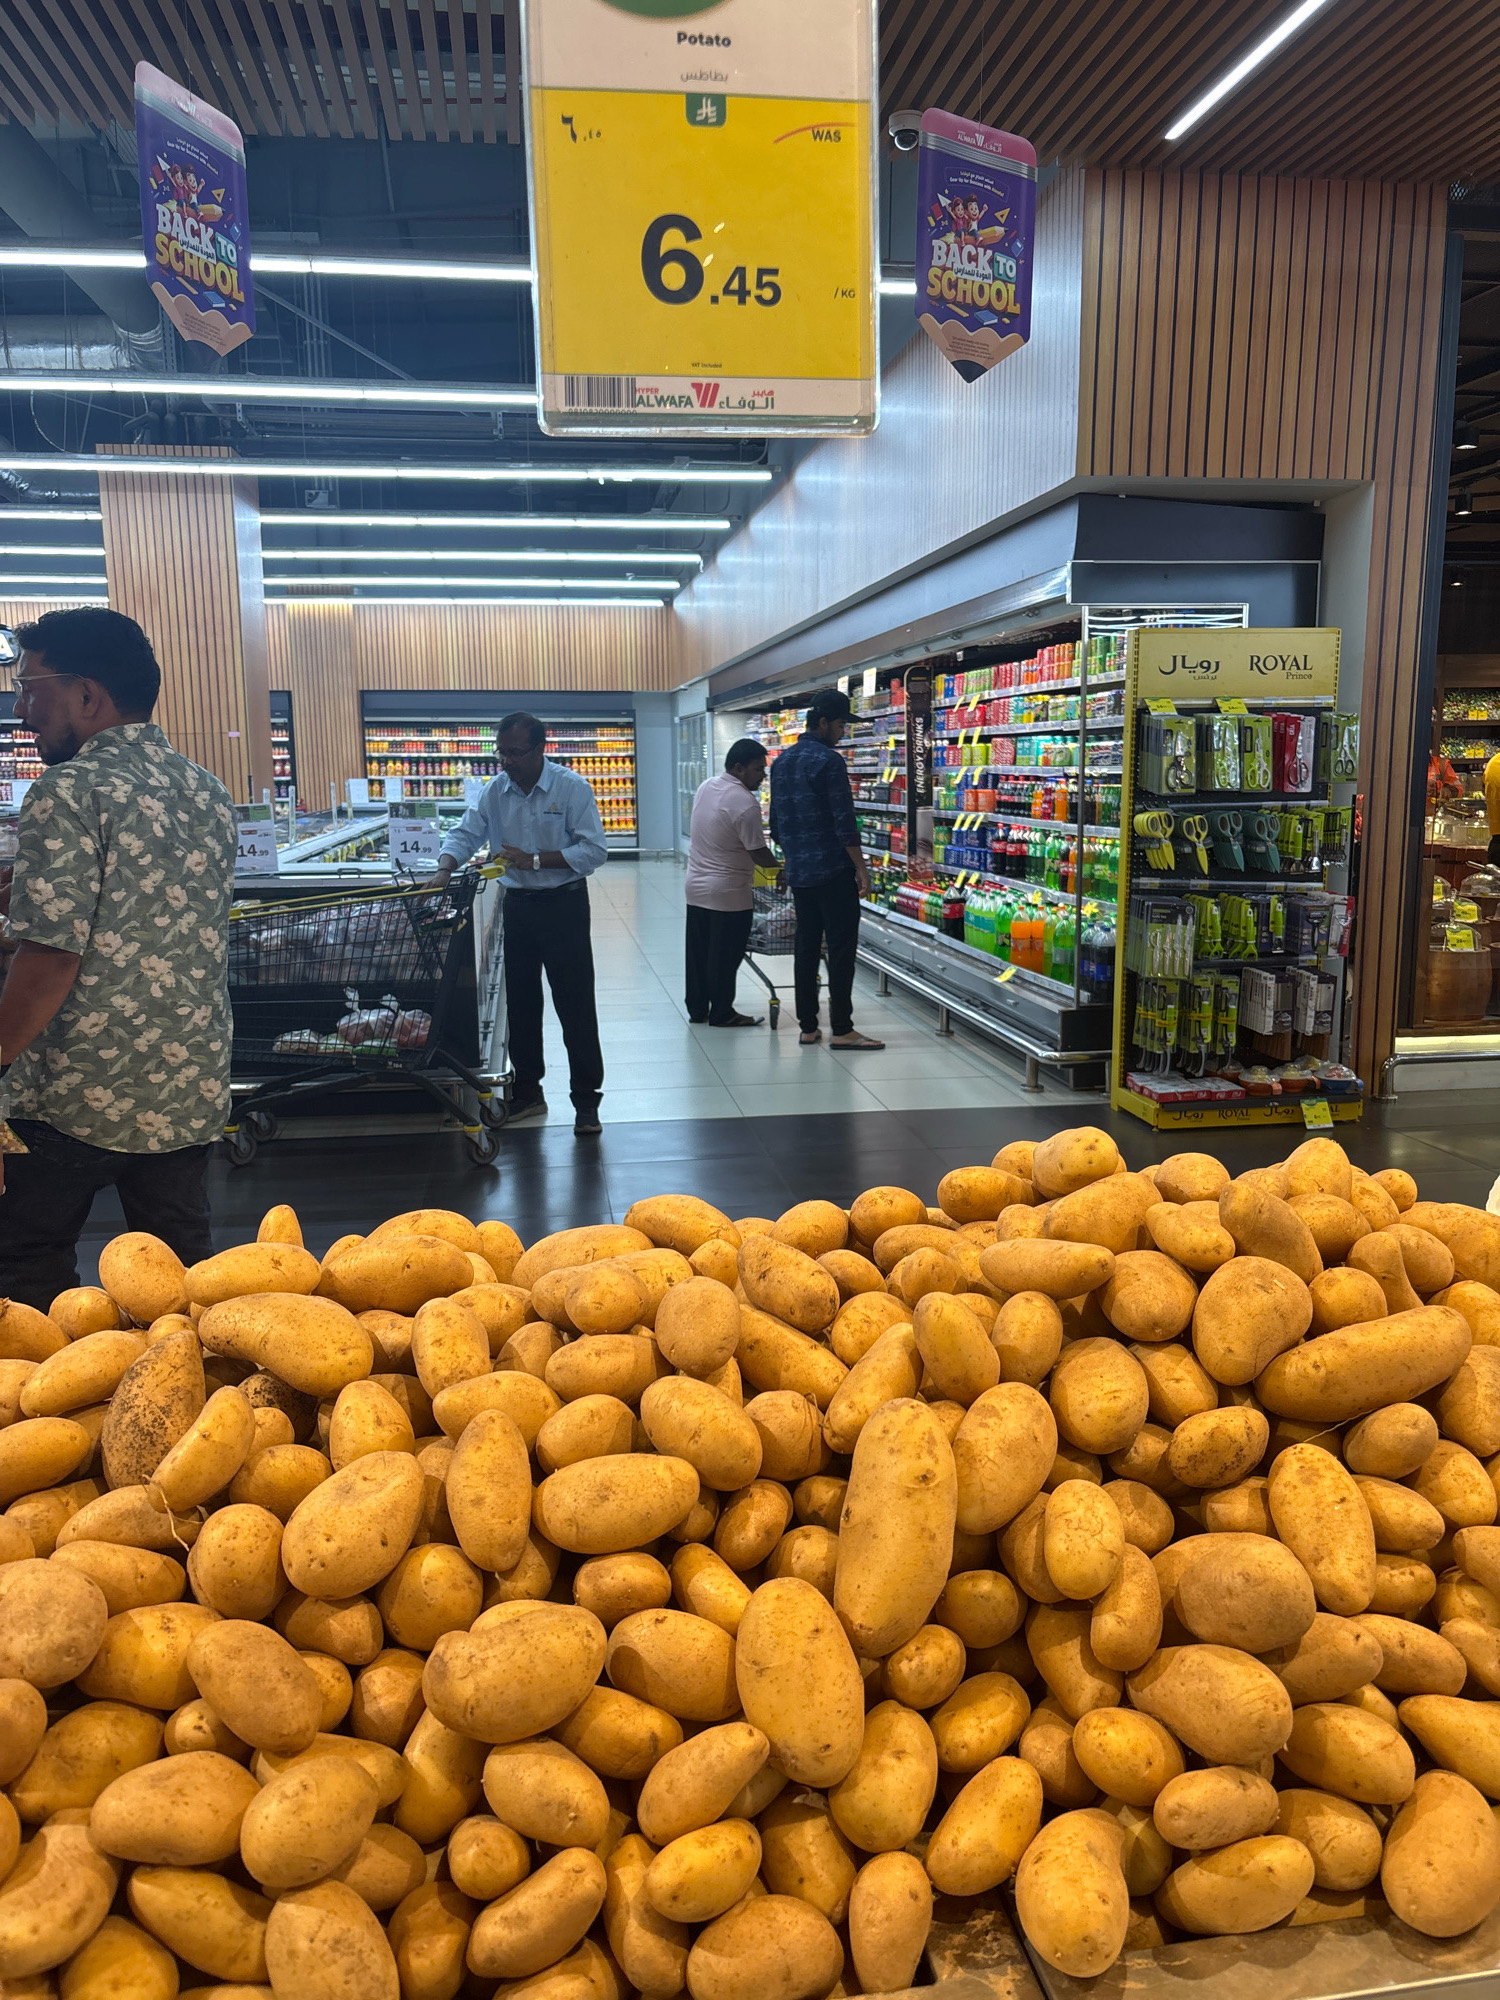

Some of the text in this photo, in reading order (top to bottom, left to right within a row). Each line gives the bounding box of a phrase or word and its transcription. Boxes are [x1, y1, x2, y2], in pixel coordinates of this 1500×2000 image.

[677, 31, 732, 47] Potato
[680, 70, 728, 82] بطاطس
[812, 129, 842, 143] WAS
[156, 203, 237, 263] BACK TO
[641, 214, 782, 307] 6.45
[931, 239, 1017, 278] BACK TO
[155, 233, 245, 303] SCHOOL
[926, 266, 1021, 315] SCHOOL
[635, 387, 660, 395] HYPER
[751, 389, 775, 398] هايبر
[636, 395, 694, 409] ALWAFA
[718, 396, 775, 411] الوفاء
[1158, 654, 1222, 676] رويال
[1249, 654, 1314, 676] ROYAL
[1285, 671, 1313, 681] Prince
[915, 716, 926, 794] ENERGY DRINKS
[237, 843, 270, 858] 14.99
[400, 840, 432, 854] 14.99
[1218, 1108, 1251, 1120] ROYAL
